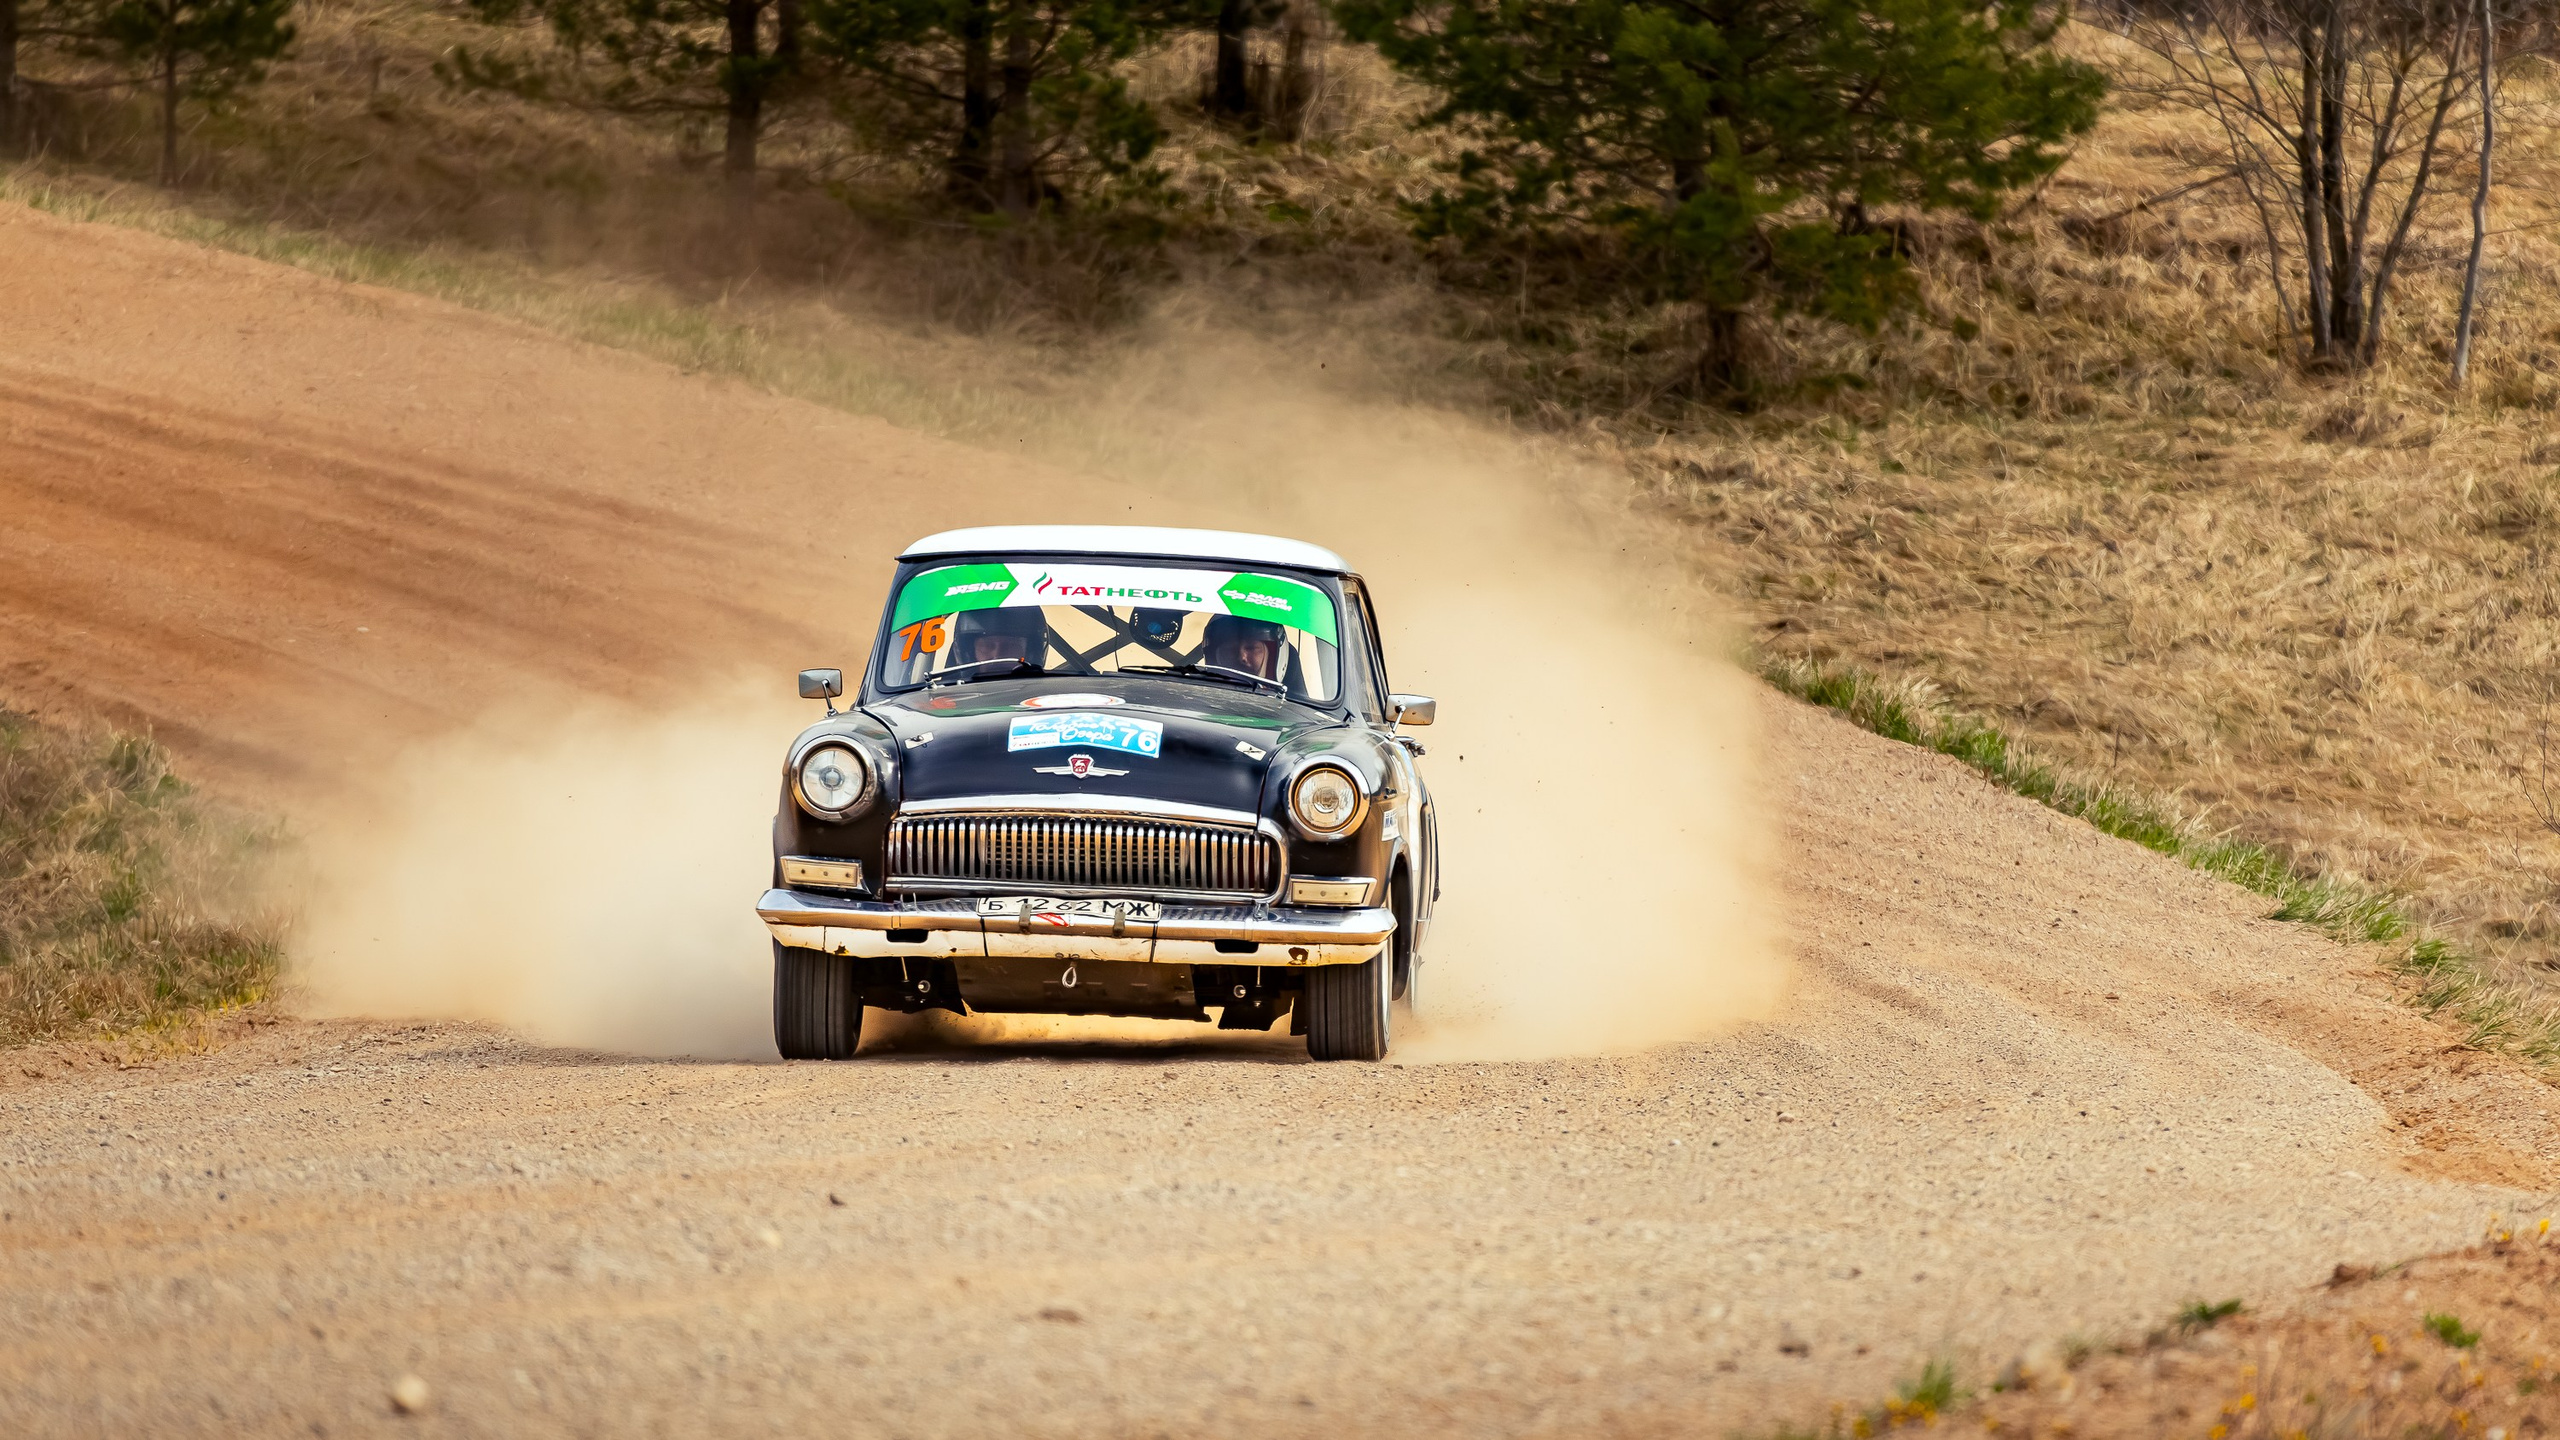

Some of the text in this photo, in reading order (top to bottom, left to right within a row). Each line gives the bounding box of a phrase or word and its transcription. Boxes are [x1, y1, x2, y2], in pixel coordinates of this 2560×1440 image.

[1057, 586, 1203, 603] ТАТНЕФТЬ
[900, 617, 946, 662] 76
[1119, 727, 1158, 752] 76
